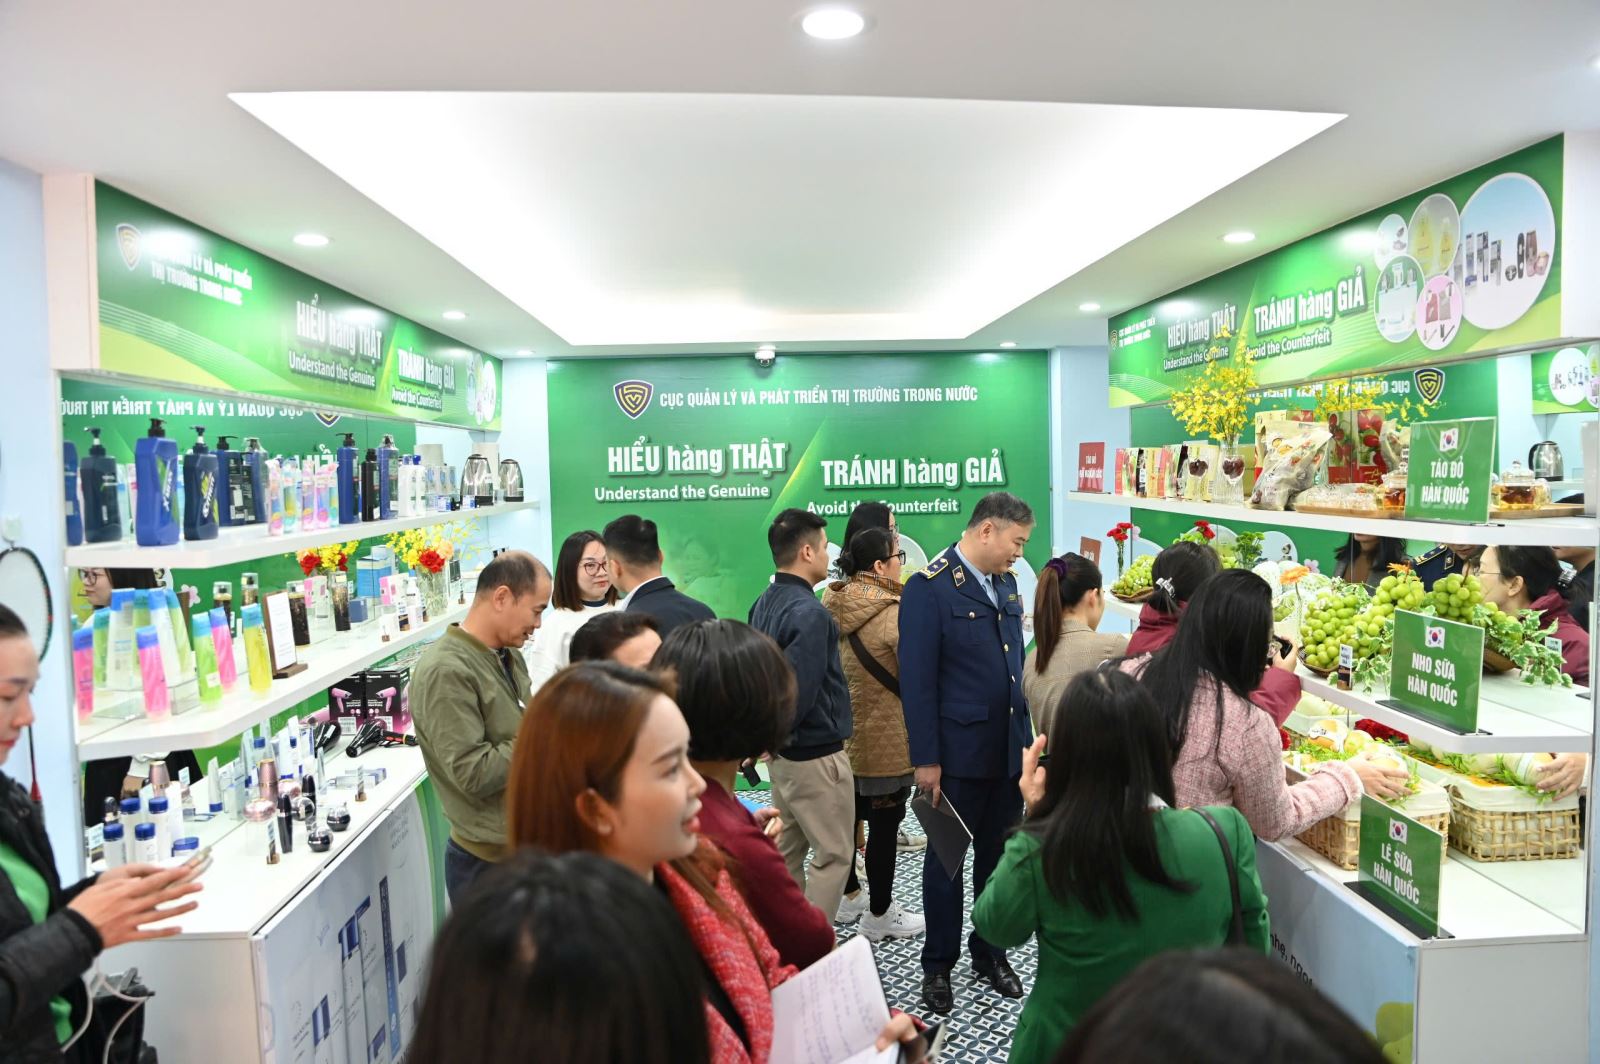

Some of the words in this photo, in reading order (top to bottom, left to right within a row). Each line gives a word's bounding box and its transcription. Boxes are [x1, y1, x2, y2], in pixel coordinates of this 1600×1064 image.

[1254, 296, 1296, 334] TRÁNH
[1298, 290, 1334, 322] hàng
[1337, 265, 1365, 312] GIẢ
[296, 293, 326, 342] HIỂU
[1267, 341, 1280, 355] the
[1281, 327, 1331, 352] Counterfeit
[288, 350, 335, 377] Understand
[336, 364, 348, 380] the
[349, 367, 375, 386] Genuine
[398, 346, 424, 381] TRÁNH
[1163, 352, 1193, 370] Understand
[1194, 350, 1203, 362] the
[660, 393, 684, 410] CỤC
[687, 387, 720, 408] QUẢN
[723, 388, 738, 406] LÝ
[740, 388, 757, 406] VÀ
[760, 388, 791, 405] PHÁT
[793, 384, 828, 404] TRIỂN
[831, 389, 850, 406] THỊ
[853, 386, 900, 403] TRƯỜNG
[903, 388, 942, 402] TRONG
[945, 385, 978, 401] NƯỚC
[607, 435, 660, 473] HIỂU
[667, 444, 723, 473] hàng
[729, 437, 786, 475] THẬT
[821, 454, 896, 486] TRÁNH
[903, 458, 958, 487] hàng
[965, 448, 1003, 483] GIẢ
[1430, 458, 1448, 479] TÁO
[1450, 455, 1464, 479] ĐỎ
[594, 485, 679, 500] Understand
[681, 485, 706, 498] the
[708, 483, 769, 498] Genuine
[807, 500, 847, 515] Avoid
[880, 499, 958, 513] ounterfeit
[1422, 482, 1441, 503] HÀN
[1443, 480, 1470, 505] QUỐC
[1411, 652, 1432, 673] NHO
[1434, 658, 1456, 681] SỮA
[1407, 674, 1428, 697] HÀN
[1430, 682, 1458, 707] QUỐC
[1381, 842, 1392, 863] LÊ
[1393, 851, 1413, 877] SỮA
[1373, 861, 1392, 887] HÀN
[1394, 875, 1420, 905] QUỐC
